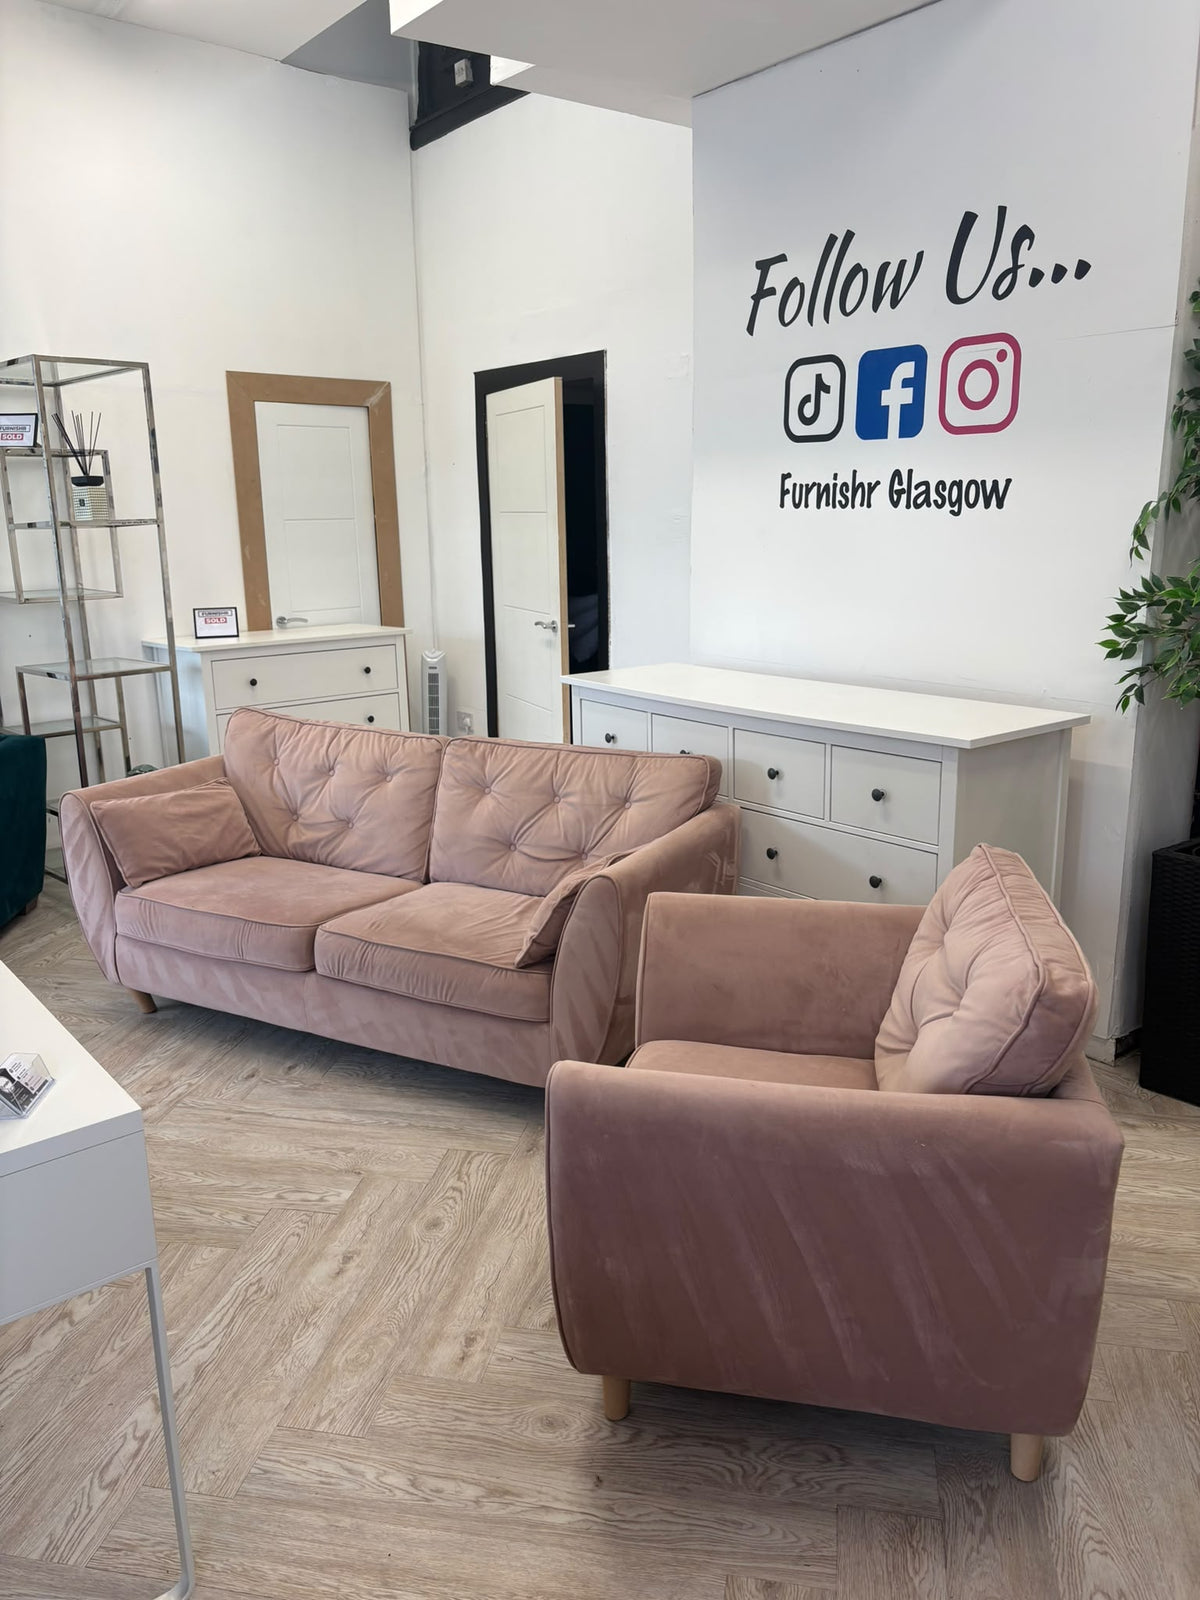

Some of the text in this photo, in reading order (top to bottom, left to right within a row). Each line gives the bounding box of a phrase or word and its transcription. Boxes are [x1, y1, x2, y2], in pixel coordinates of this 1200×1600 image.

[746, 205, 1091, 337] Follow Us...
[779, 469, 1012, 517] Furnishr Glasgow
